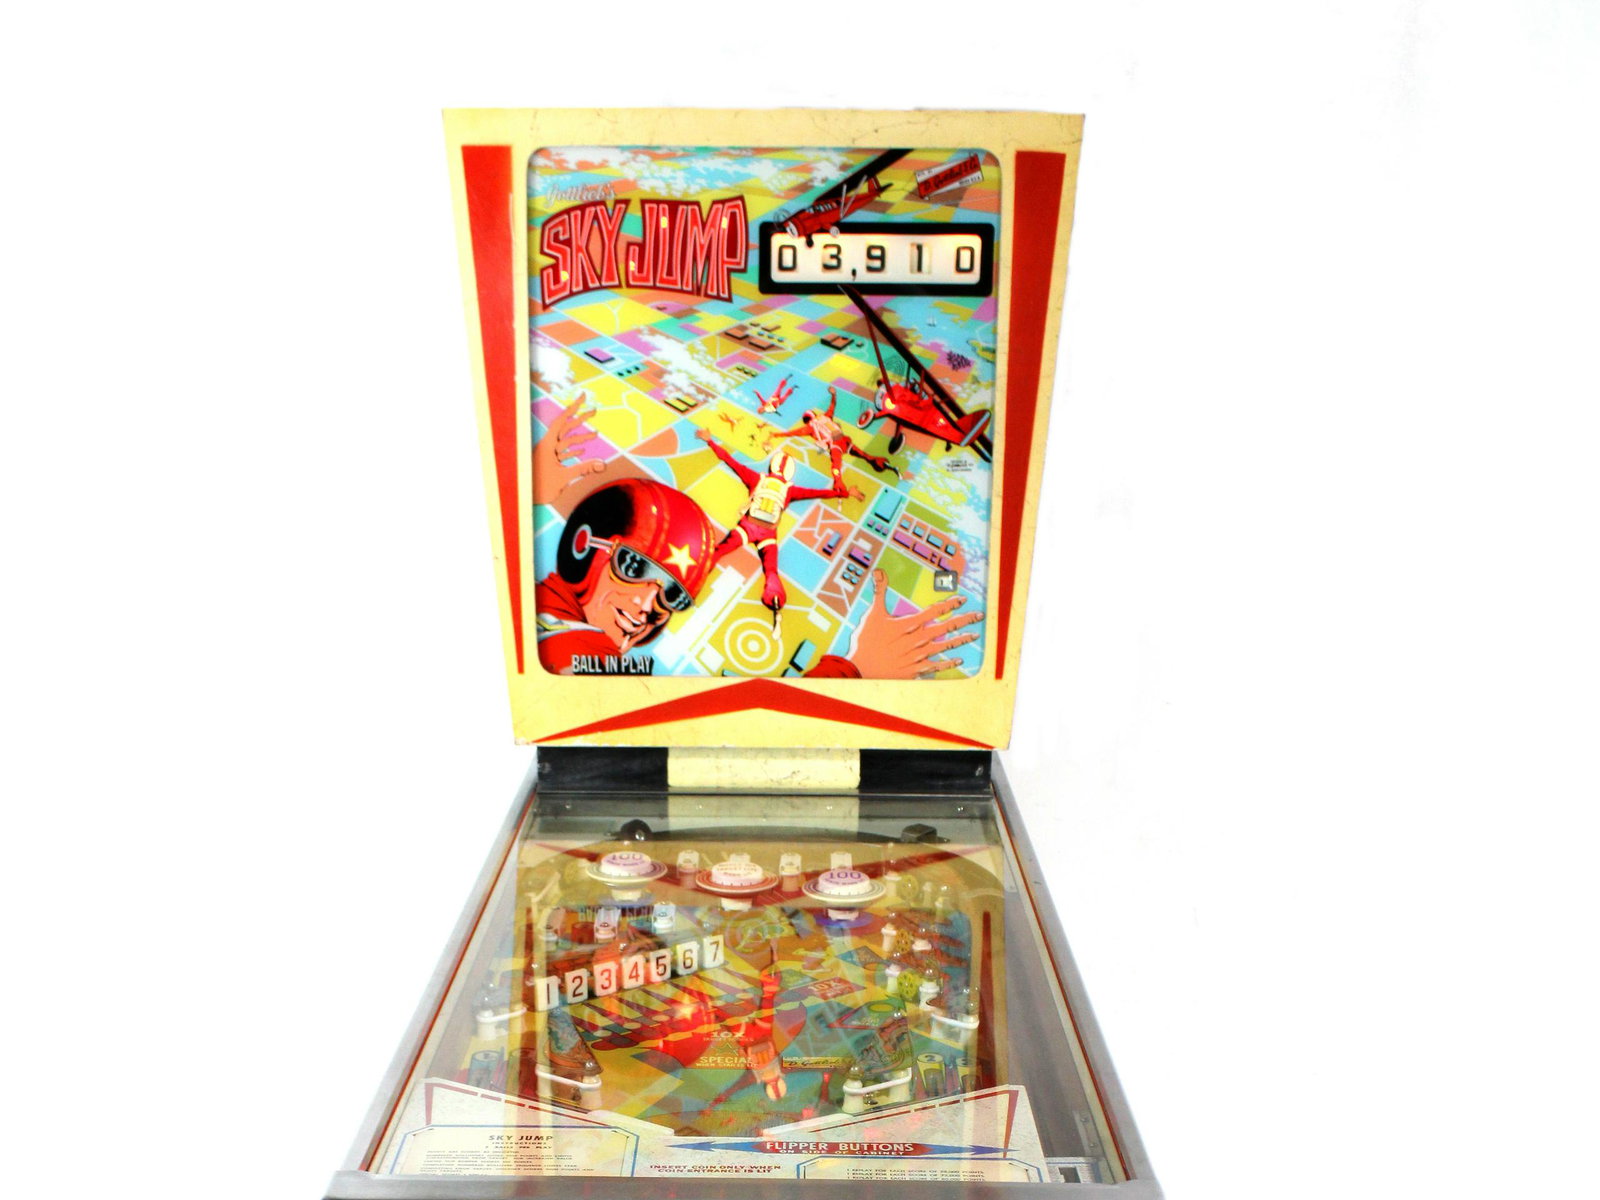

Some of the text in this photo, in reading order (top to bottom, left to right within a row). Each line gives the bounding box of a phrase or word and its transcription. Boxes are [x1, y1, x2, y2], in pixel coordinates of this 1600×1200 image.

[543, 184, 616, 209] Gottlieb's
[541, 199, 747, 307] SKY JUMP
[572, 654, 652, 673] BALL IN PLAY
[829, 871, 861, 879] 100
[571, 975, 584, 998] 2
[600, 968, 612, 991] 3
[628, 961, 641, 983] 4
[655, 955, 667, 977] 5
[682, 949, 694, 970] 6
[709, 940, 720, 963] 7
[766, 1141, 914, 1152] FLIPPER BUTTONS
